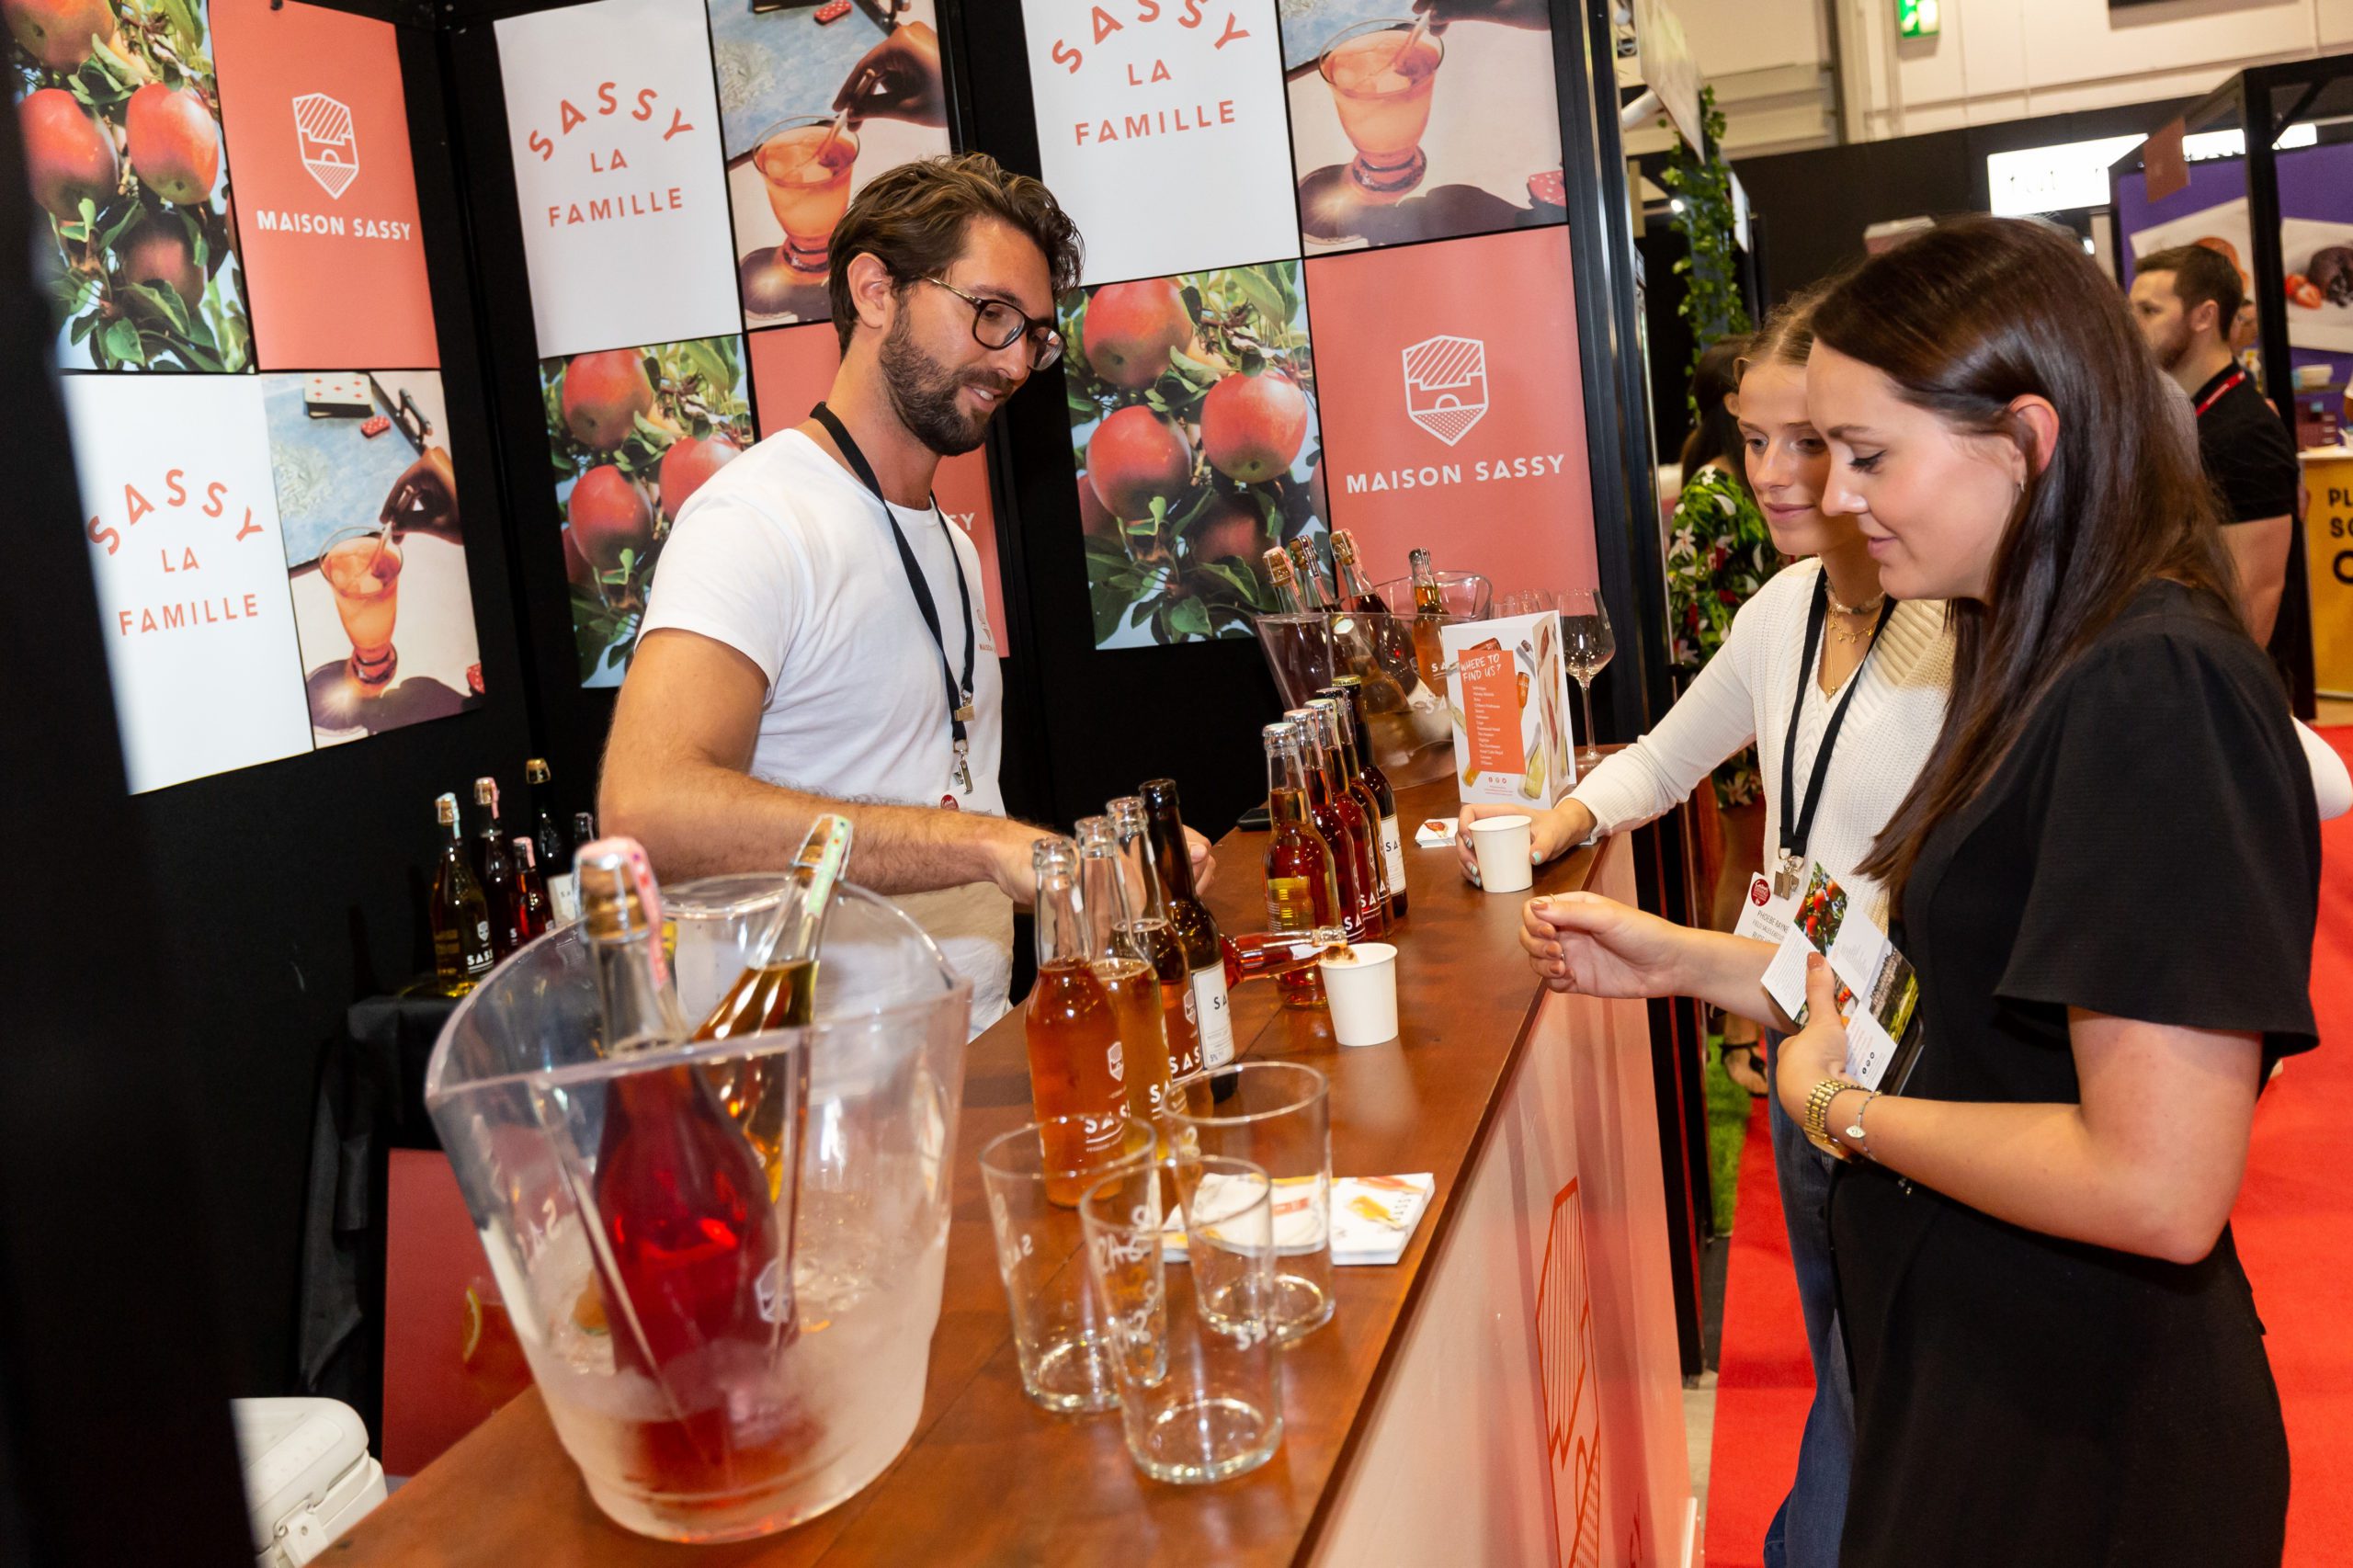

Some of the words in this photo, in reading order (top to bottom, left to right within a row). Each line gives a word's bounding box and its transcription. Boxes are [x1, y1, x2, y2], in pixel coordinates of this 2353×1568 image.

[1051, 0, 1252, 74] SASSY
[1128, 59, 1172, 86] LA
[529, 82, 695, 161] SASSY
[1074, 99, 1235, 146] FAMILLE
[591, 149, 628, 174] LA
[256, 210, 345, 237] MAISON
[353, 219, 411, 242] SASSY
[548, 187, 684, 228] FAMILLE
[1347, 464, 1461, 494] MAISON
[1475, 454, 1565, 482] SASSY
[87, 468, 265, 555] SASSY
[161, 546, 200, 573] LA
[119, 593, 259, 636] FAMILLE
[1461, 656, 1486, 672] WHERE
[1487, 653, 1500, 665] TO
[1462, 670, 1483, 682] FIND
